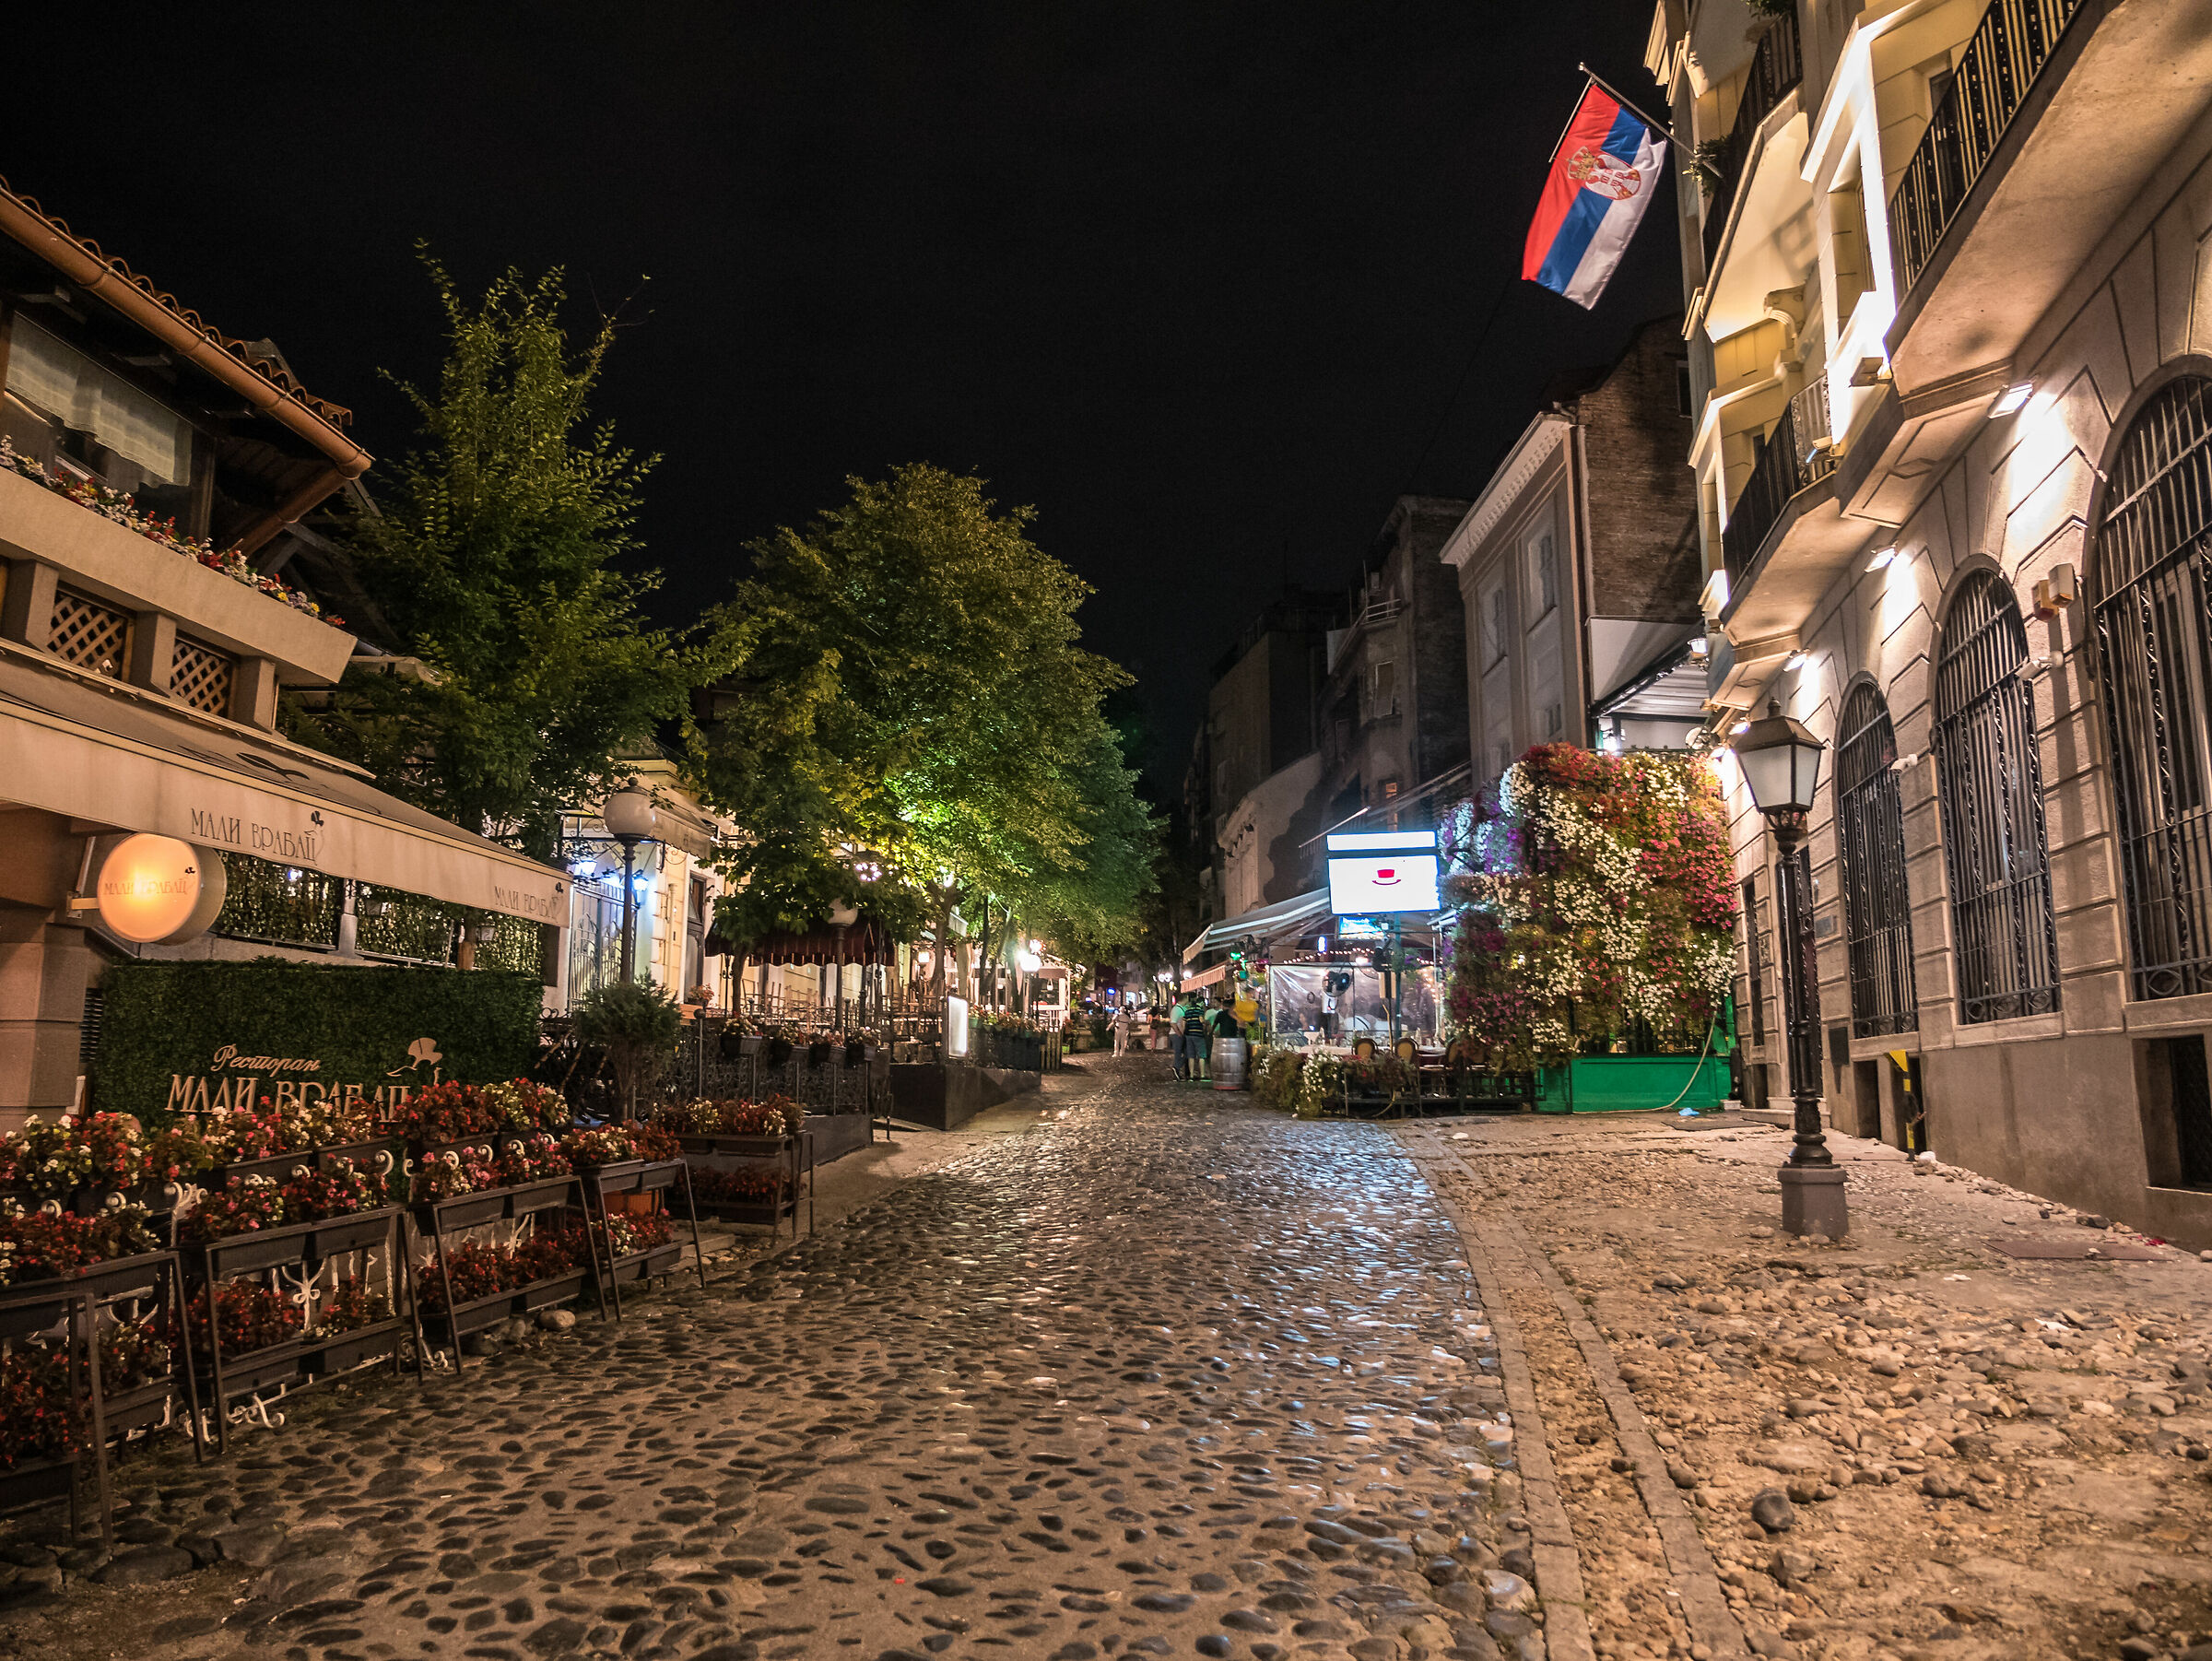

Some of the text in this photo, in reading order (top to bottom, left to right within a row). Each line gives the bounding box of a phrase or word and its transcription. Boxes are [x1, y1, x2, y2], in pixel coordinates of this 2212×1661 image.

[191, 807, 319, 866] МАЛИ ВРАБАЦ
[138, 878, 188, 895] РАБАЦ
[494, 885, 519, 911] МАЛИ
[210, 1043, 321, 1078] Ресторан
[164, 1074, 259, 1114] МАЛИ
